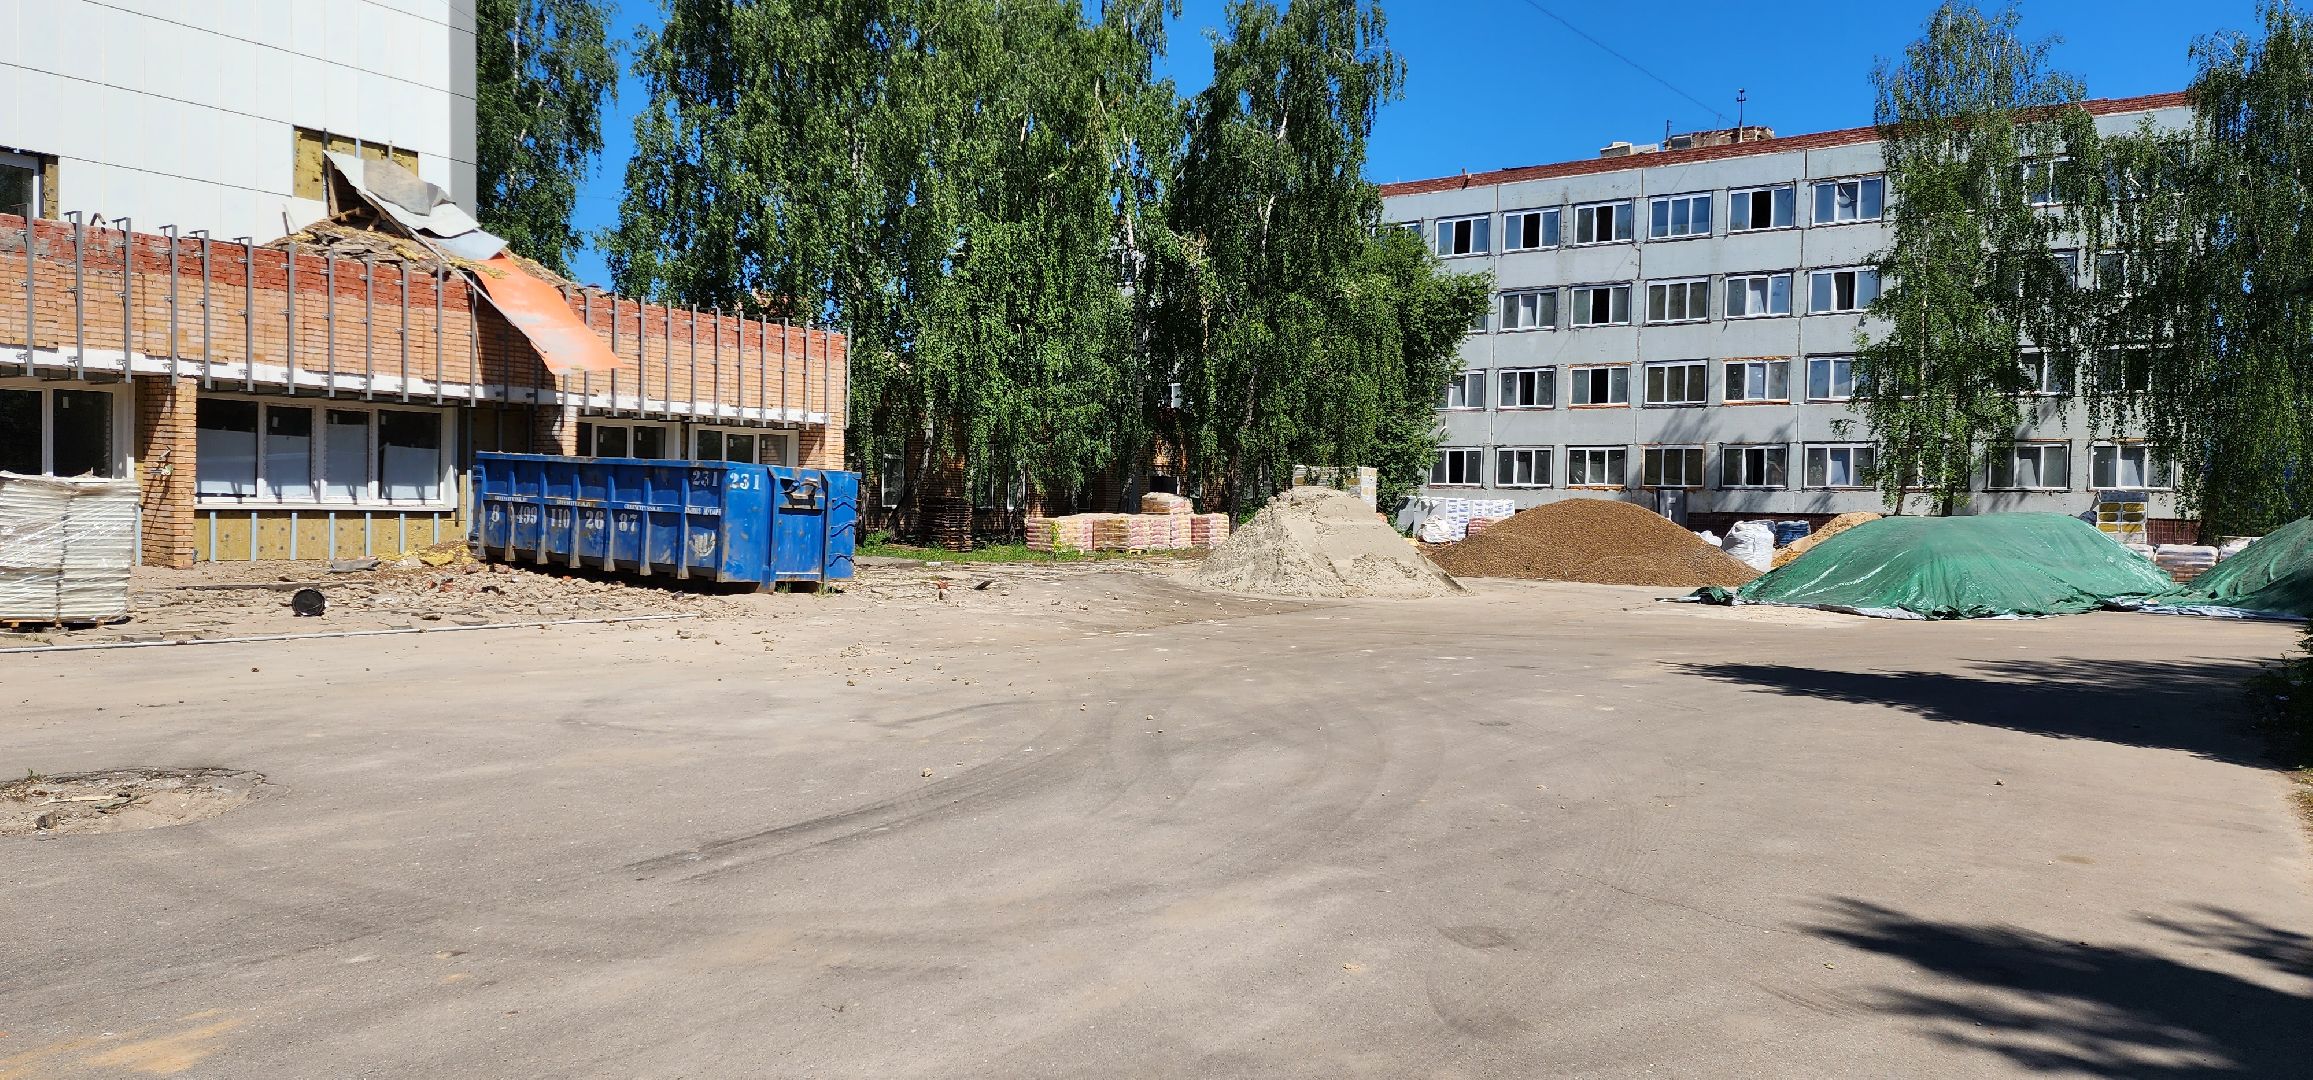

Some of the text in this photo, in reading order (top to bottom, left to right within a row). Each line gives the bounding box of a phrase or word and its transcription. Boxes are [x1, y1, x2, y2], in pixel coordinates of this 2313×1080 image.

[692, 469, 718, 487] 231
[729, 472, 760, 490] 231
[491, 504, 638, 532] 8 499 110 26 87
